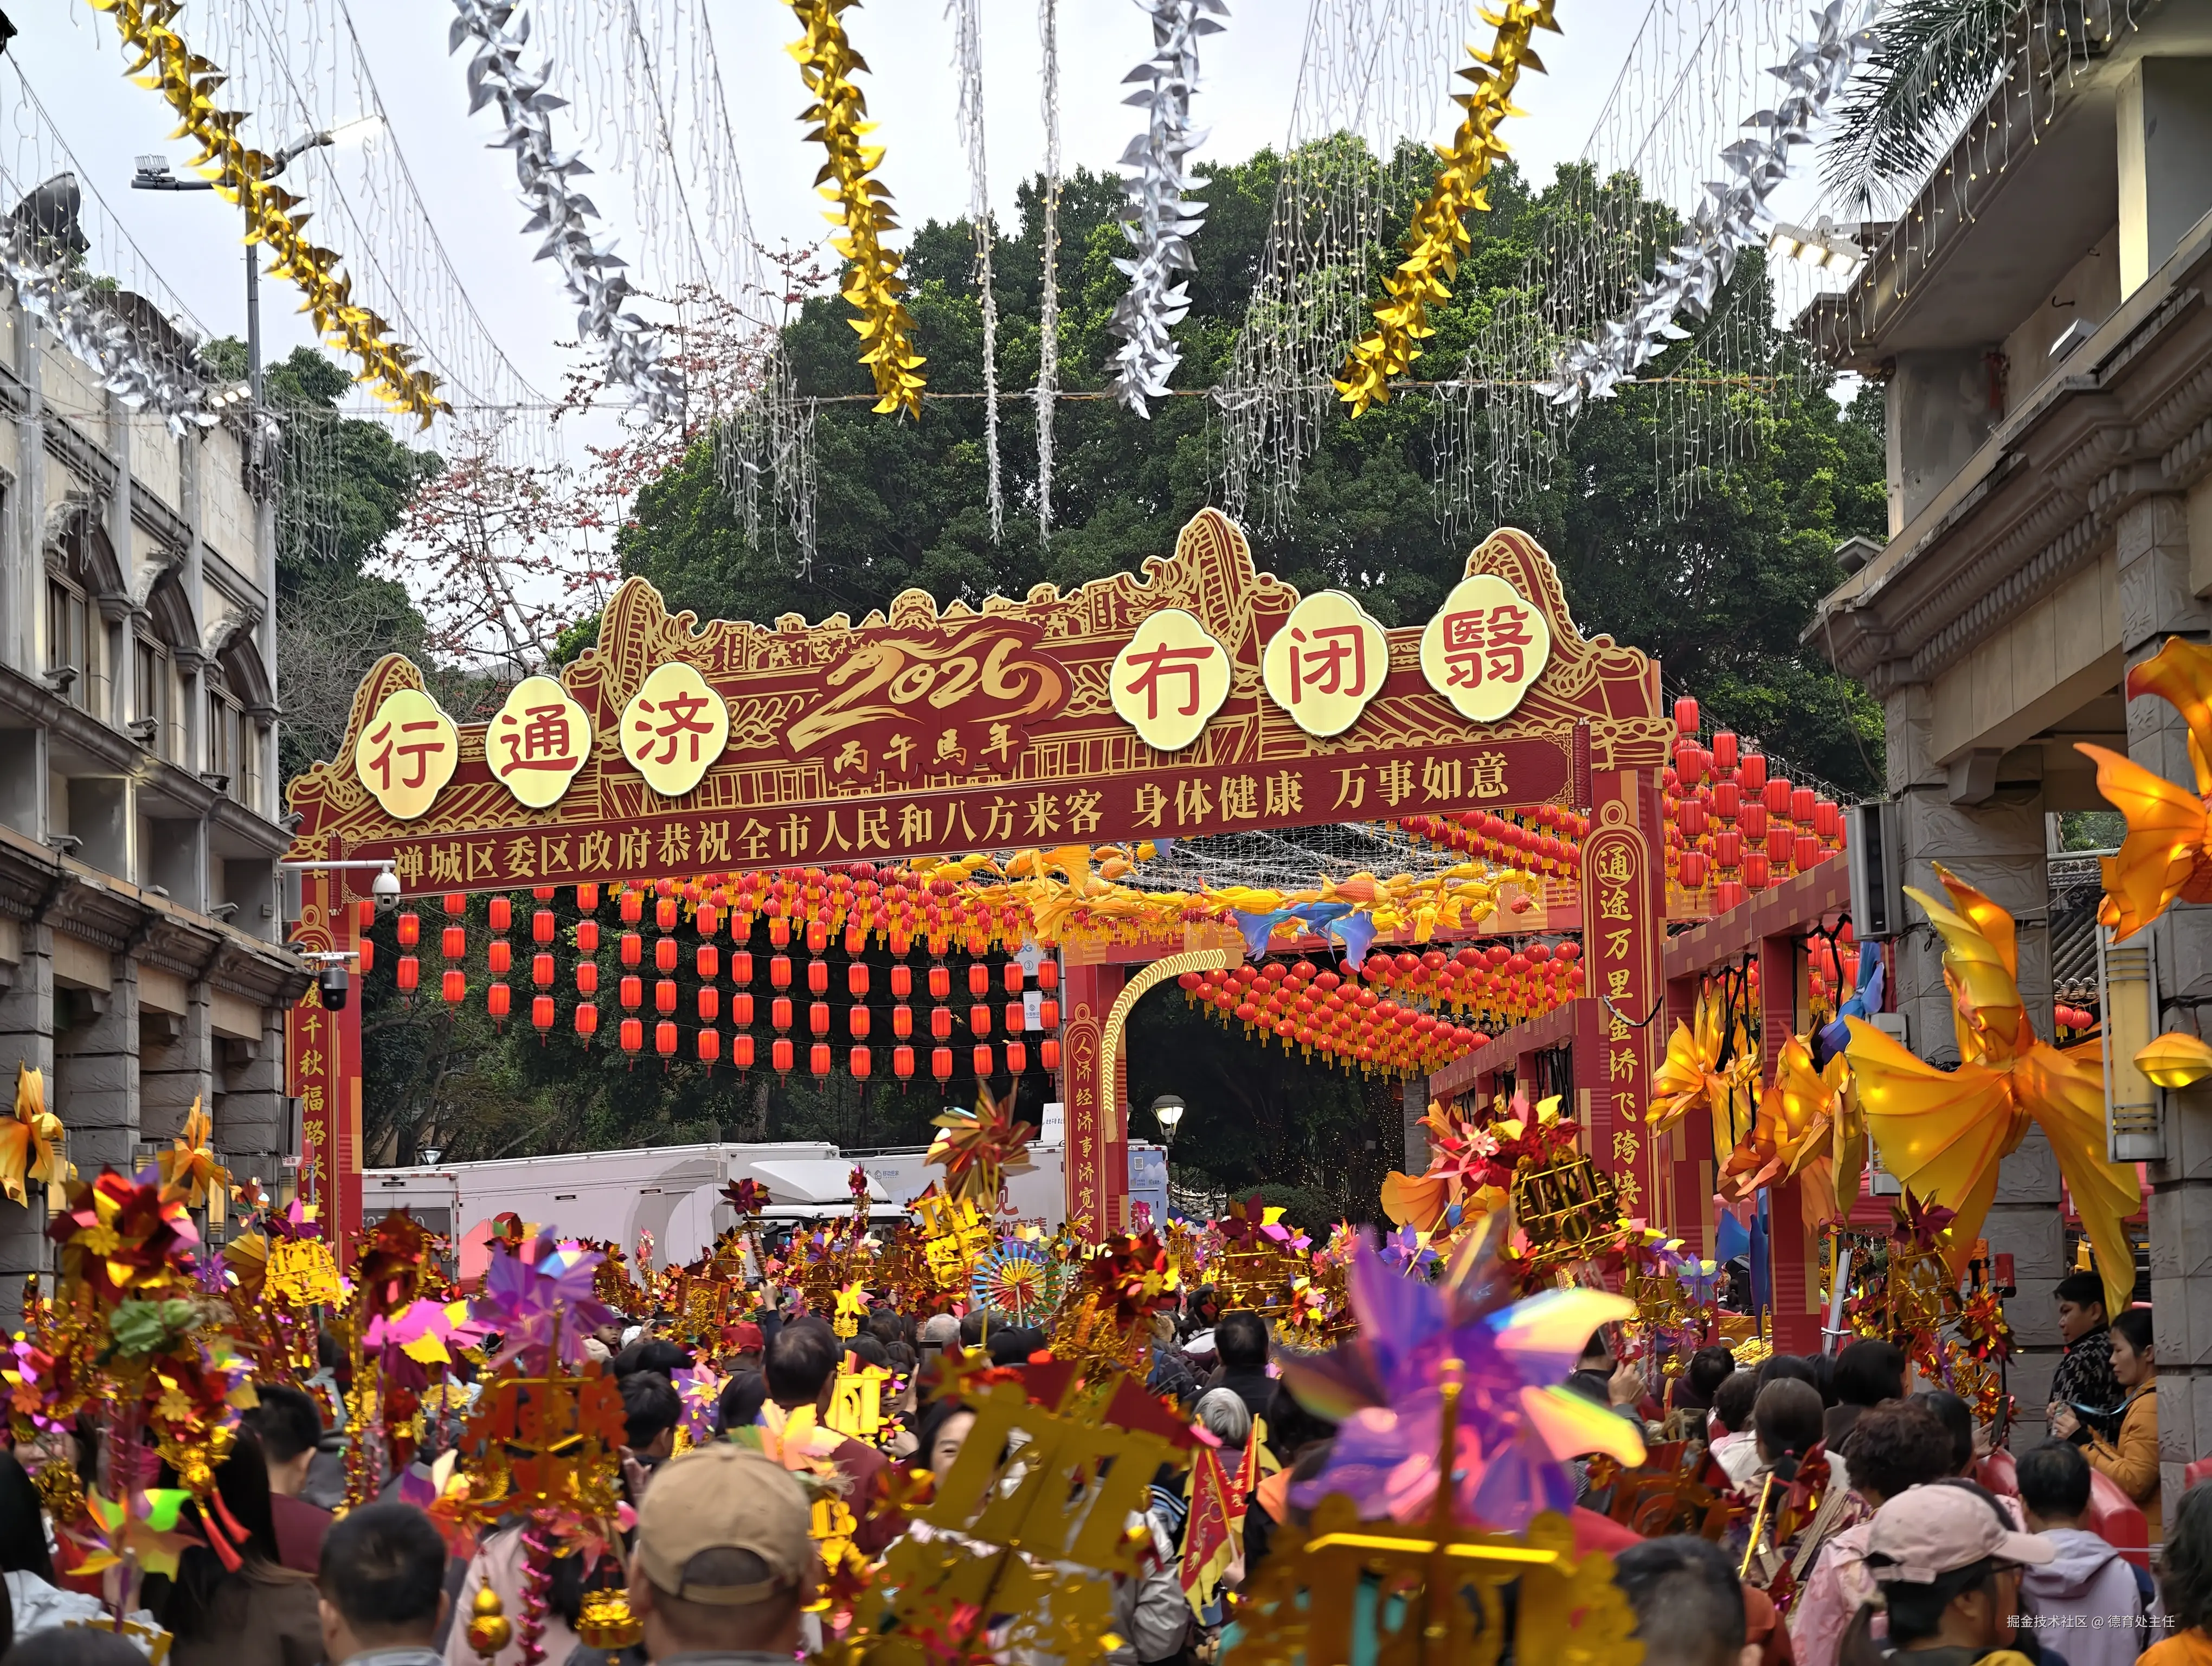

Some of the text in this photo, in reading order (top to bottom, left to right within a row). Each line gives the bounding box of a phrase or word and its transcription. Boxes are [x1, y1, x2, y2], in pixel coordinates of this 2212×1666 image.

[369, 691, 714, 790] 行通济
[787, 633, 1063, 753] 2026
[393, 751, 1509, 887] 禅城区委区政府恭祝全市人民和八方来客 身体健康 万事如意
